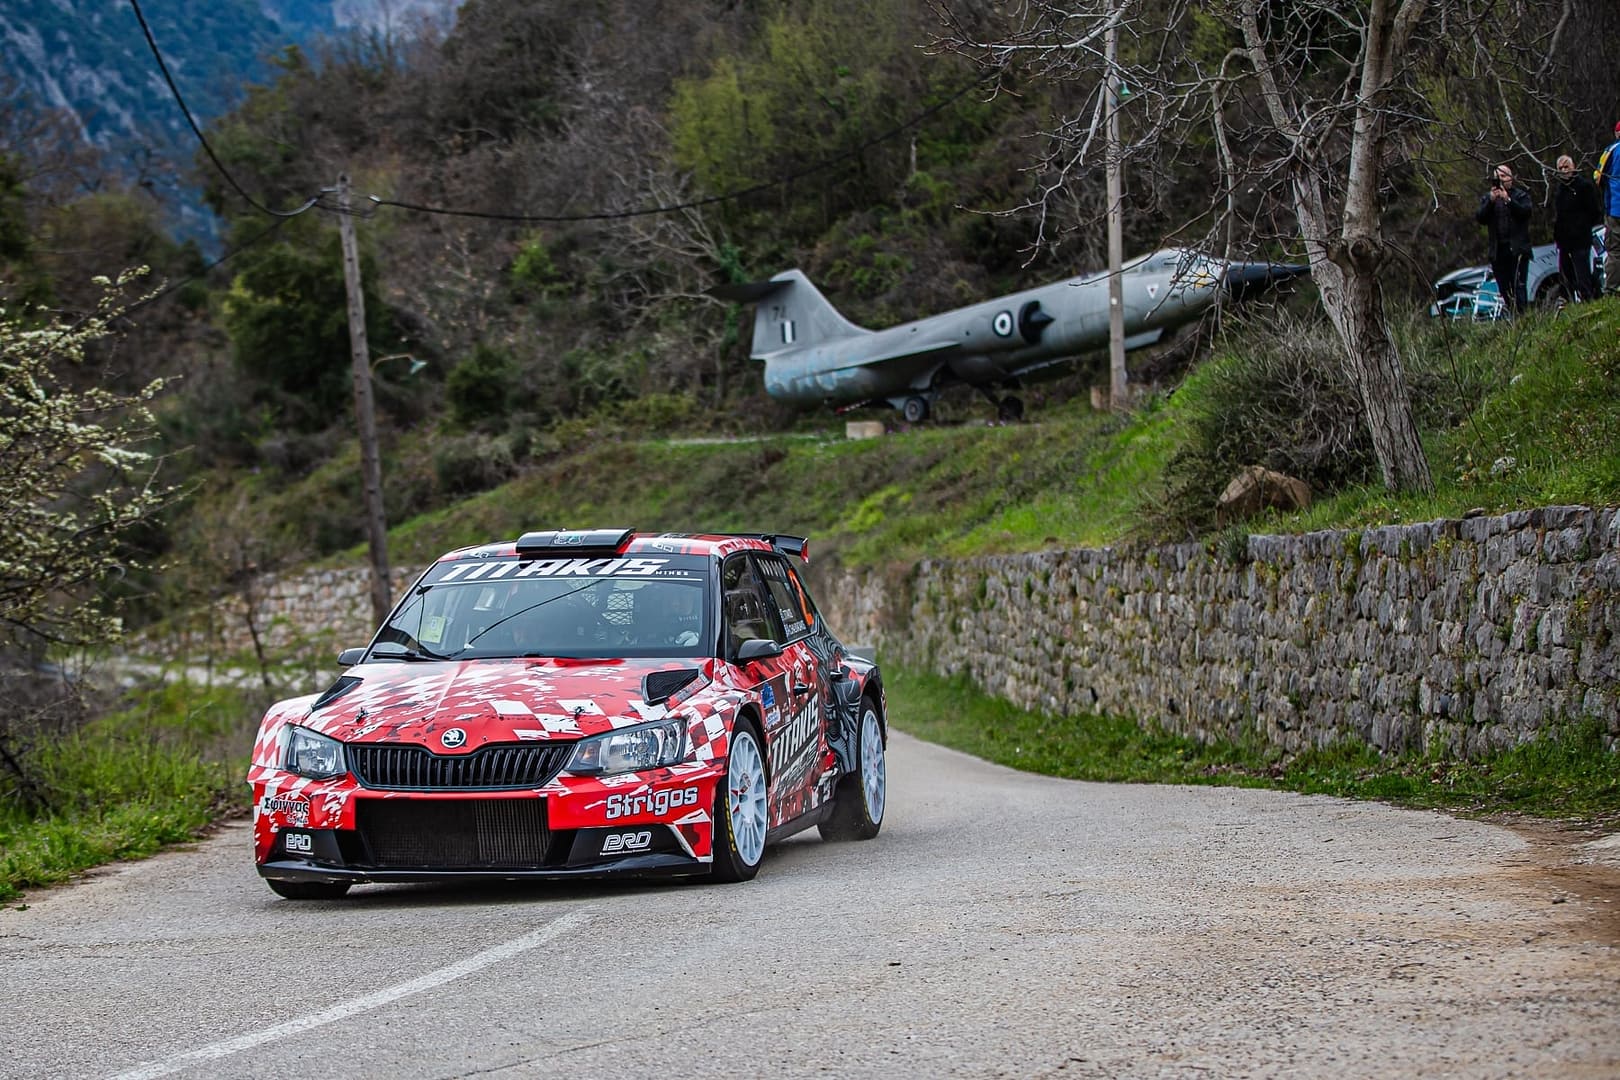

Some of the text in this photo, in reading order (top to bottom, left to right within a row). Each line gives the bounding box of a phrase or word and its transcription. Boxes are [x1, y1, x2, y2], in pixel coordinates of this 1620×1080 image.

[439, 558, 670, 582] TITAKIS
[771, 692, 818, 777] TITAKIS
[606, 786, 698, 820] Strigos
